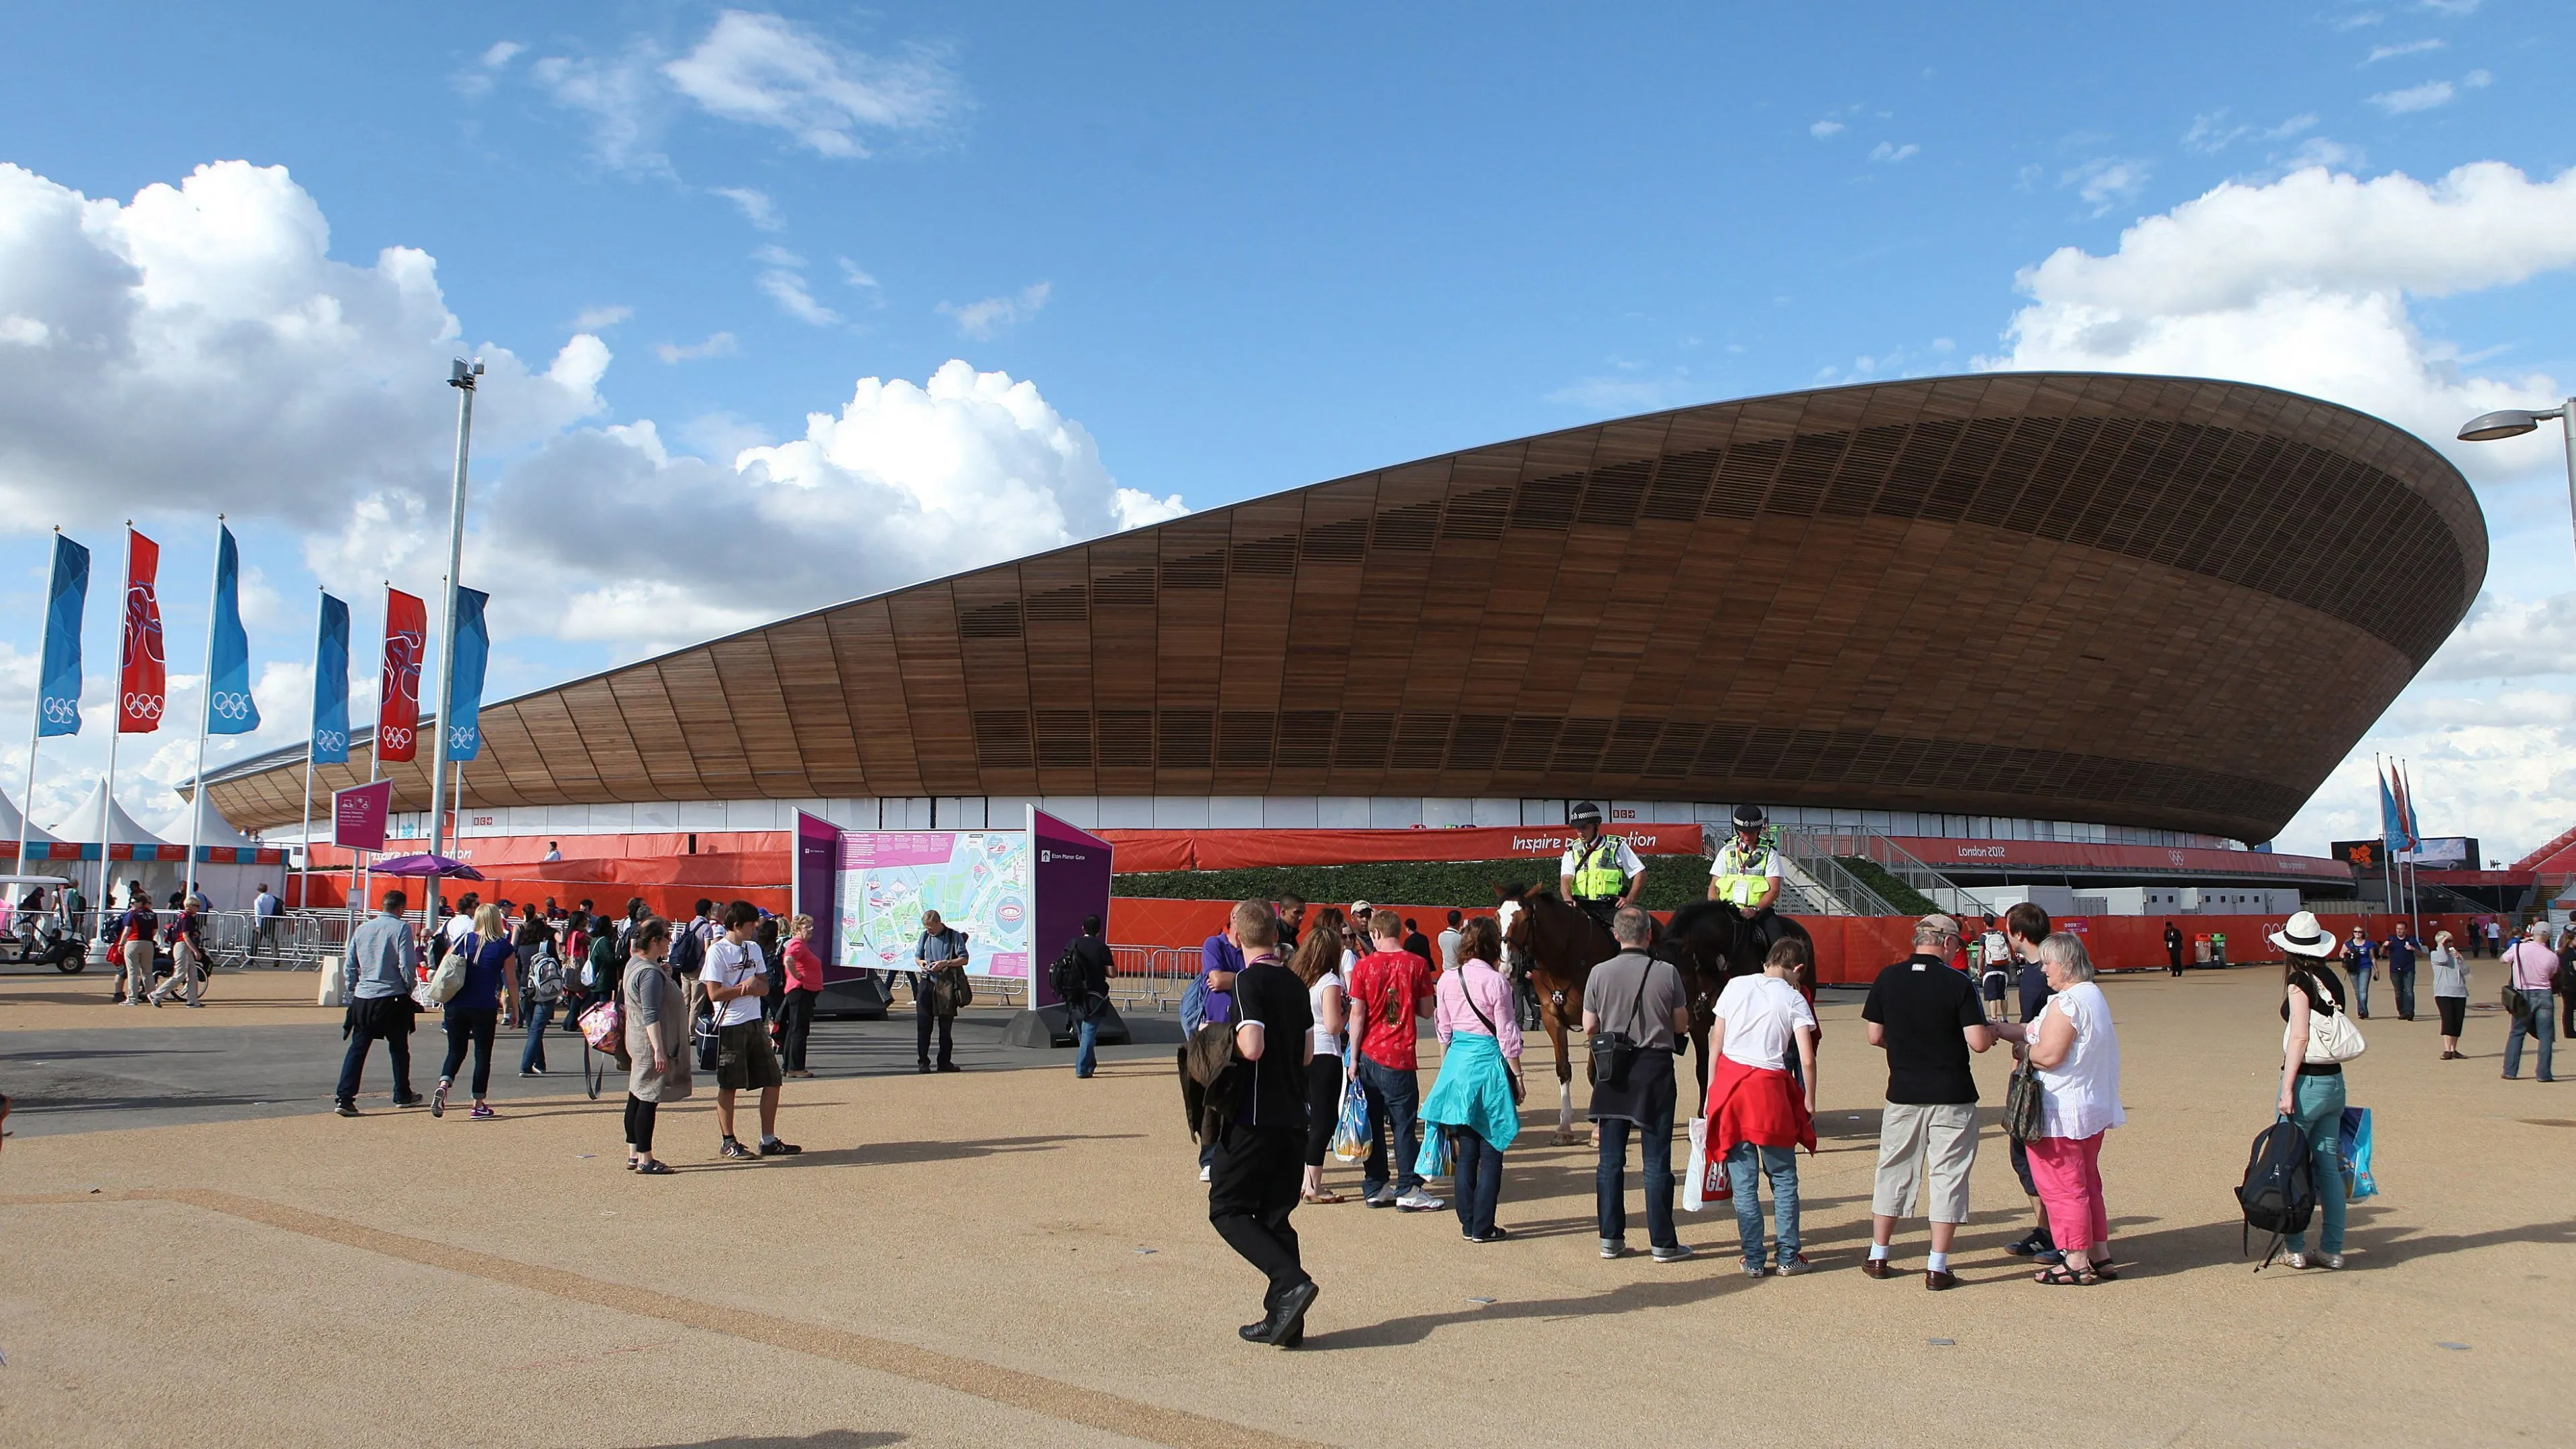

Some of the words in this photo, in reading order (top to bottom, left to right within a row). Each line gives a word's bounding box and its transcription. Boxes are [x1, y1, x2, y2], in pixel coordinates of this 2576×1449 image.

[1513, 833, 1560, 853] Inspire
[1957, 845, 1986, 857] London
[1988, 846, 2005, 857] 2012
